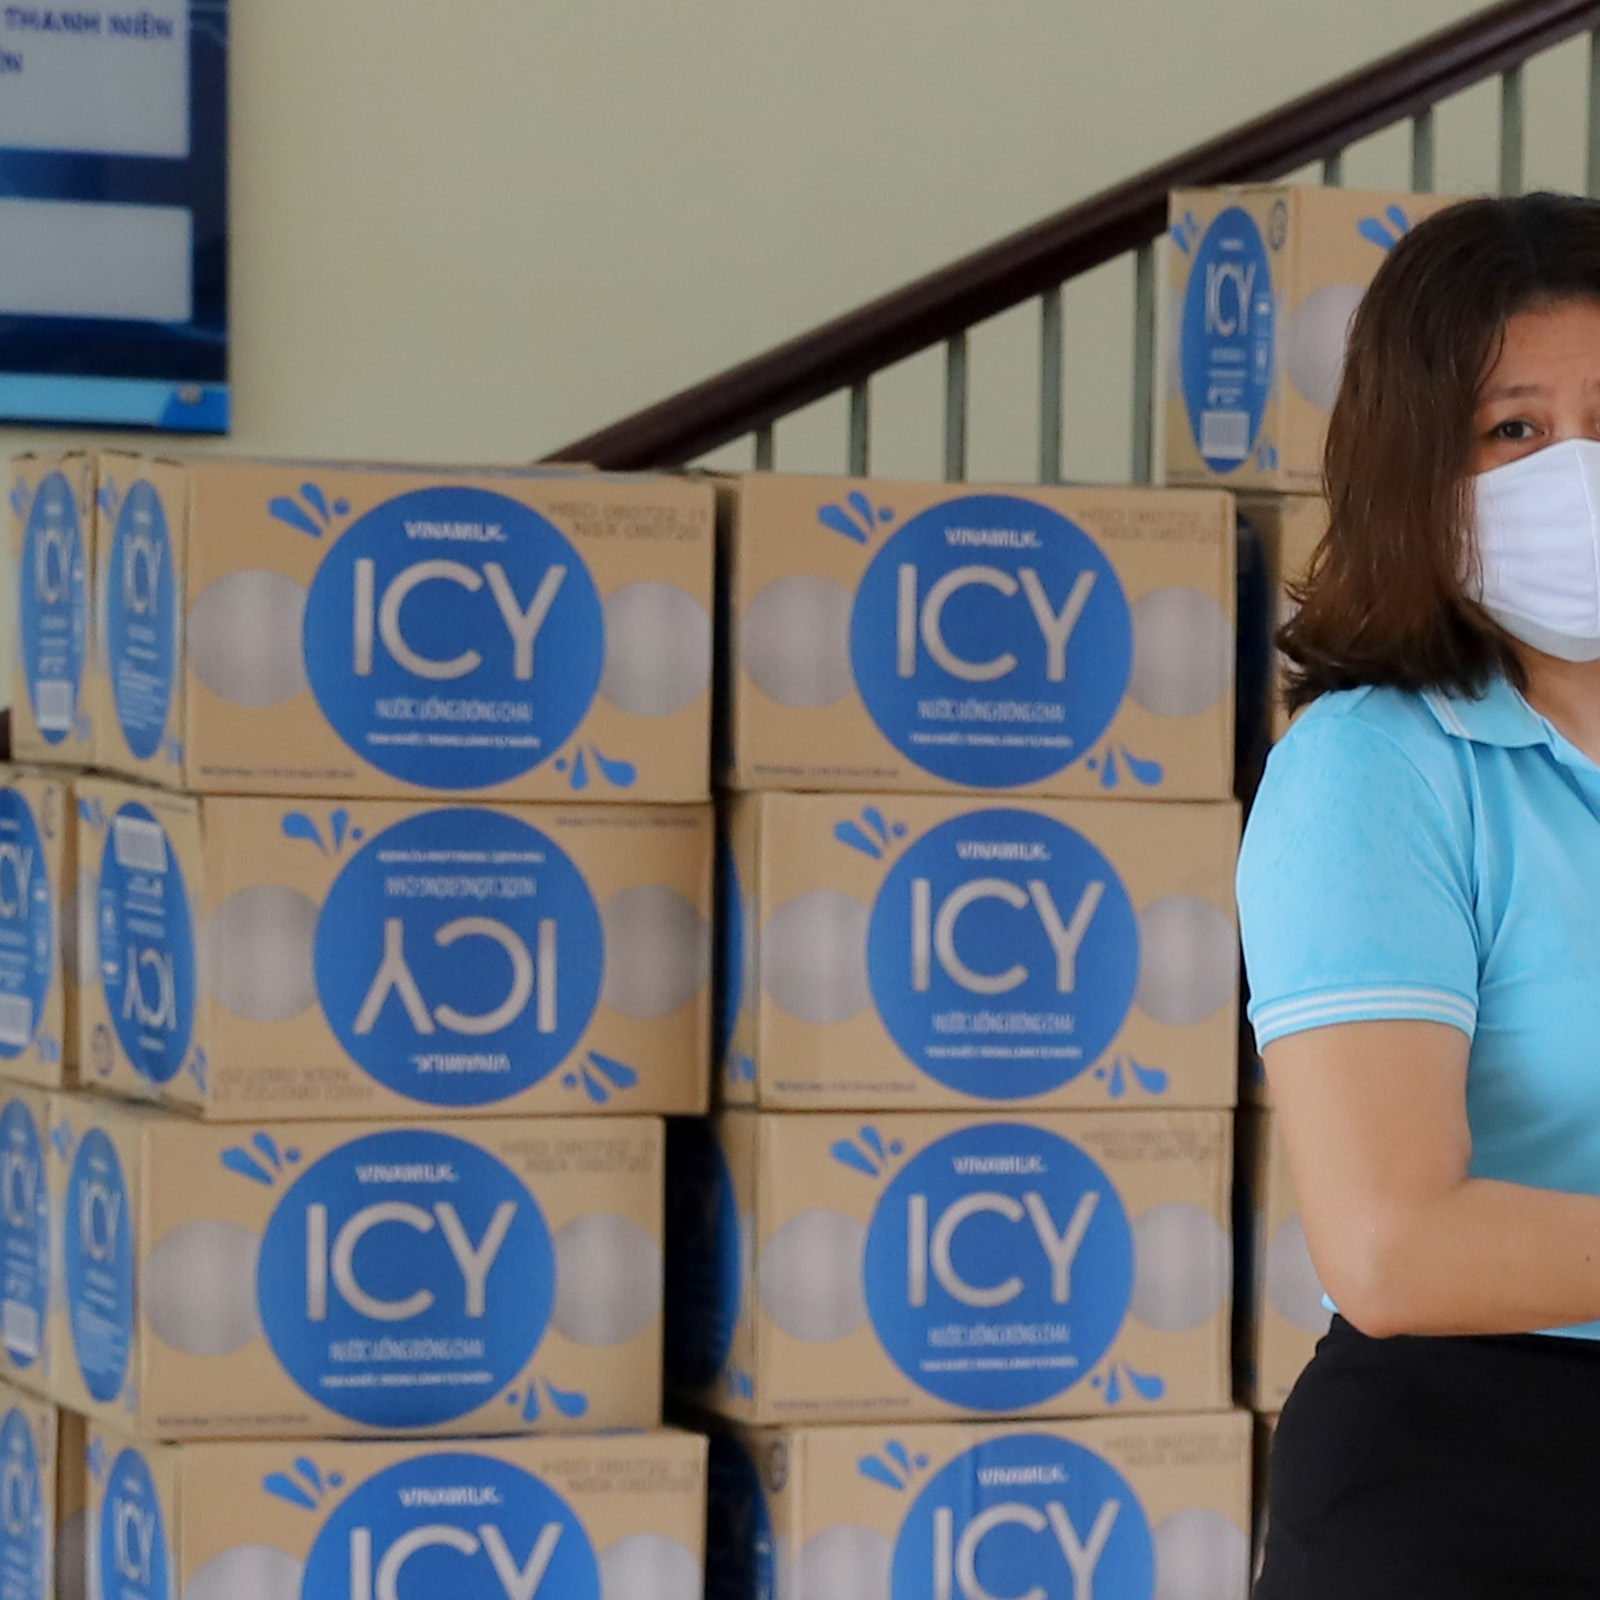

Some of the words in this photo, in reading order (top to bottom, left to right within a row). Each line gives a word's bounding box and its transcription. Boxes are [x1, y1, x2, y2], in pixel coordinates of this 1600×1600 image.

[1205, 262, 1257, 337] ICY
[405, 521, 506, 541] VINAMILK
[945, 528, 1040, 548] VINAMILK
[354, 558, 566, 680] ICY
[898, 564, 1096, 681] ICY
[957, 842, 1049, 860] VINAMILK
[354, 917, 557, 1034] ICY
[912, 878, 1104, 994] ICY
[357, 1164, 456, 1182] VINAMILK
[307, 1202, 517, 1320] ICY
[908, 1192, 1099, 1306] ICY
[399, 1487, 500, 1506] VINAMILK
